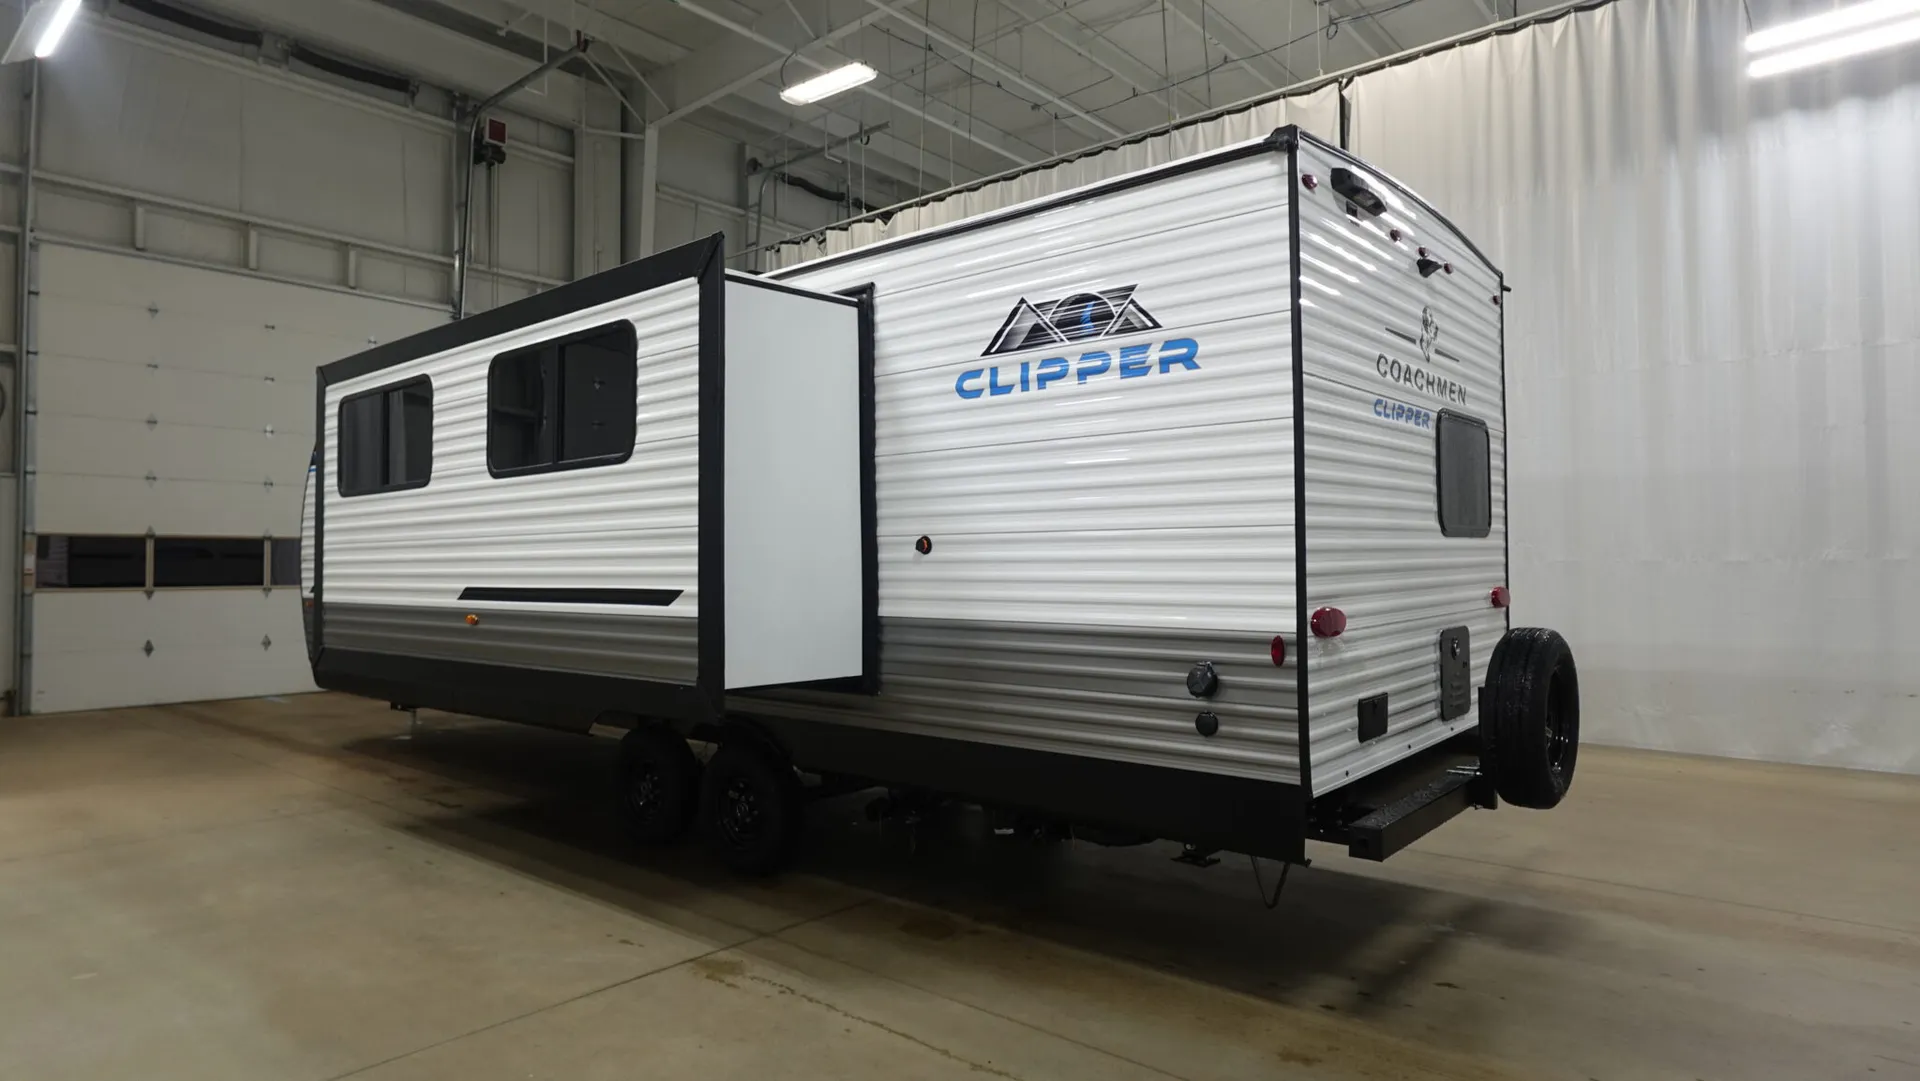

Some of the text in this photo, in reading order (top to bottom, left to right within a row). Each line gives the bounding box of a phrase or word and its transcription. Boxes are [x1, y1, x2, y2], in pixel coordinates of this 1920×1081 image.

[955, 337, 1201, 400] CLIPPER
[1377, 353, 1467, 405] COACHMEN
[1374, 398, 1431, 429] CLIPPER
